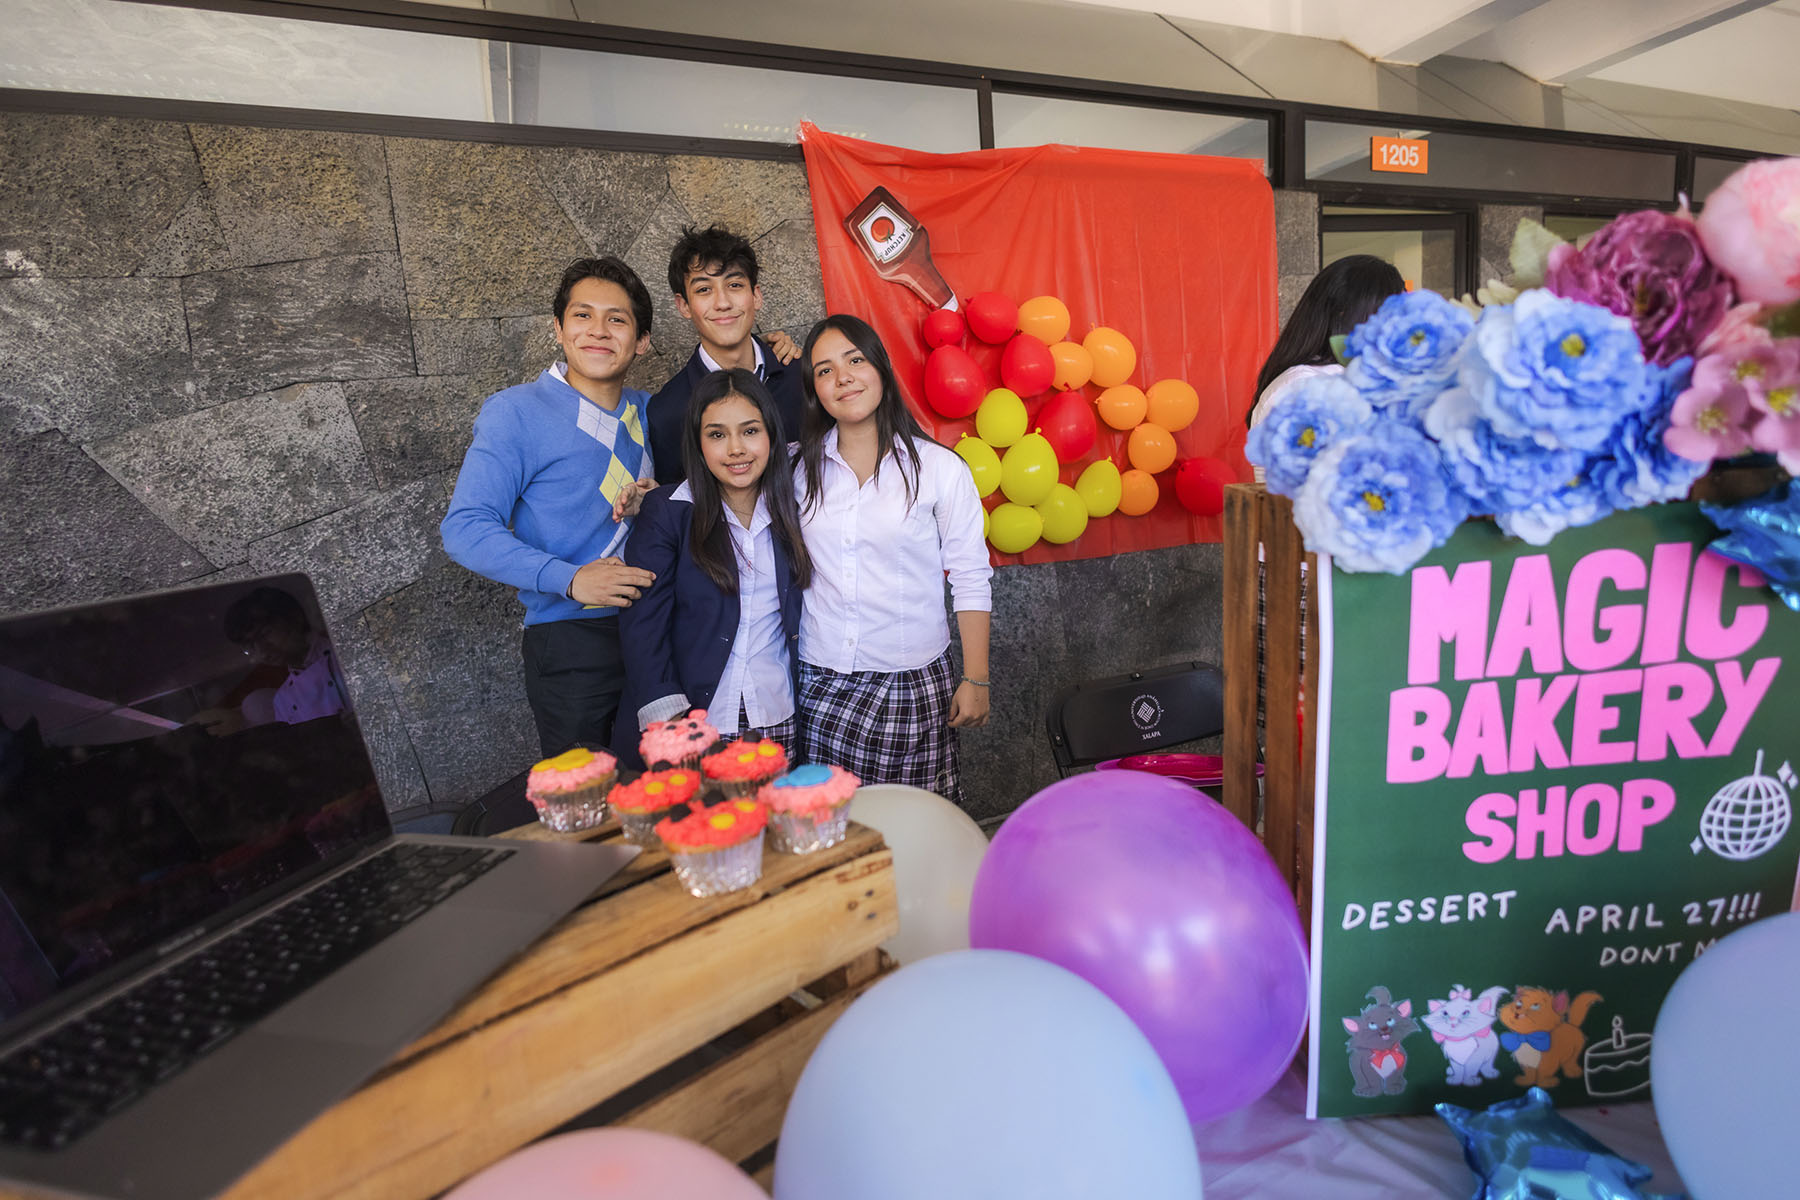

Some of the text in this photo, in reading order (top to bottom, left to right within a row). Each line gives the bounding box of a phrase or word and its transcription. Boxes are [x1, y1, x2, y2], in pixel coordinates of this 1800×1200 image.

[1380, 144, 1419, 166] 1205
[884, 233, 907, 256] KETCHUP
[1407, 542, 1769, 685] MAGIC
[1142, 731, 1161, 740] XALAPA
[1386, 657, 1782, 783] BAKERY
[1462, 778, 1676, 864] SHOP
[1341, 890, 1518, 931] DESSERT
[1544, 892, 1761, 934] APRIL 27!!!
[1599, 941, 1683, 967] DONT
